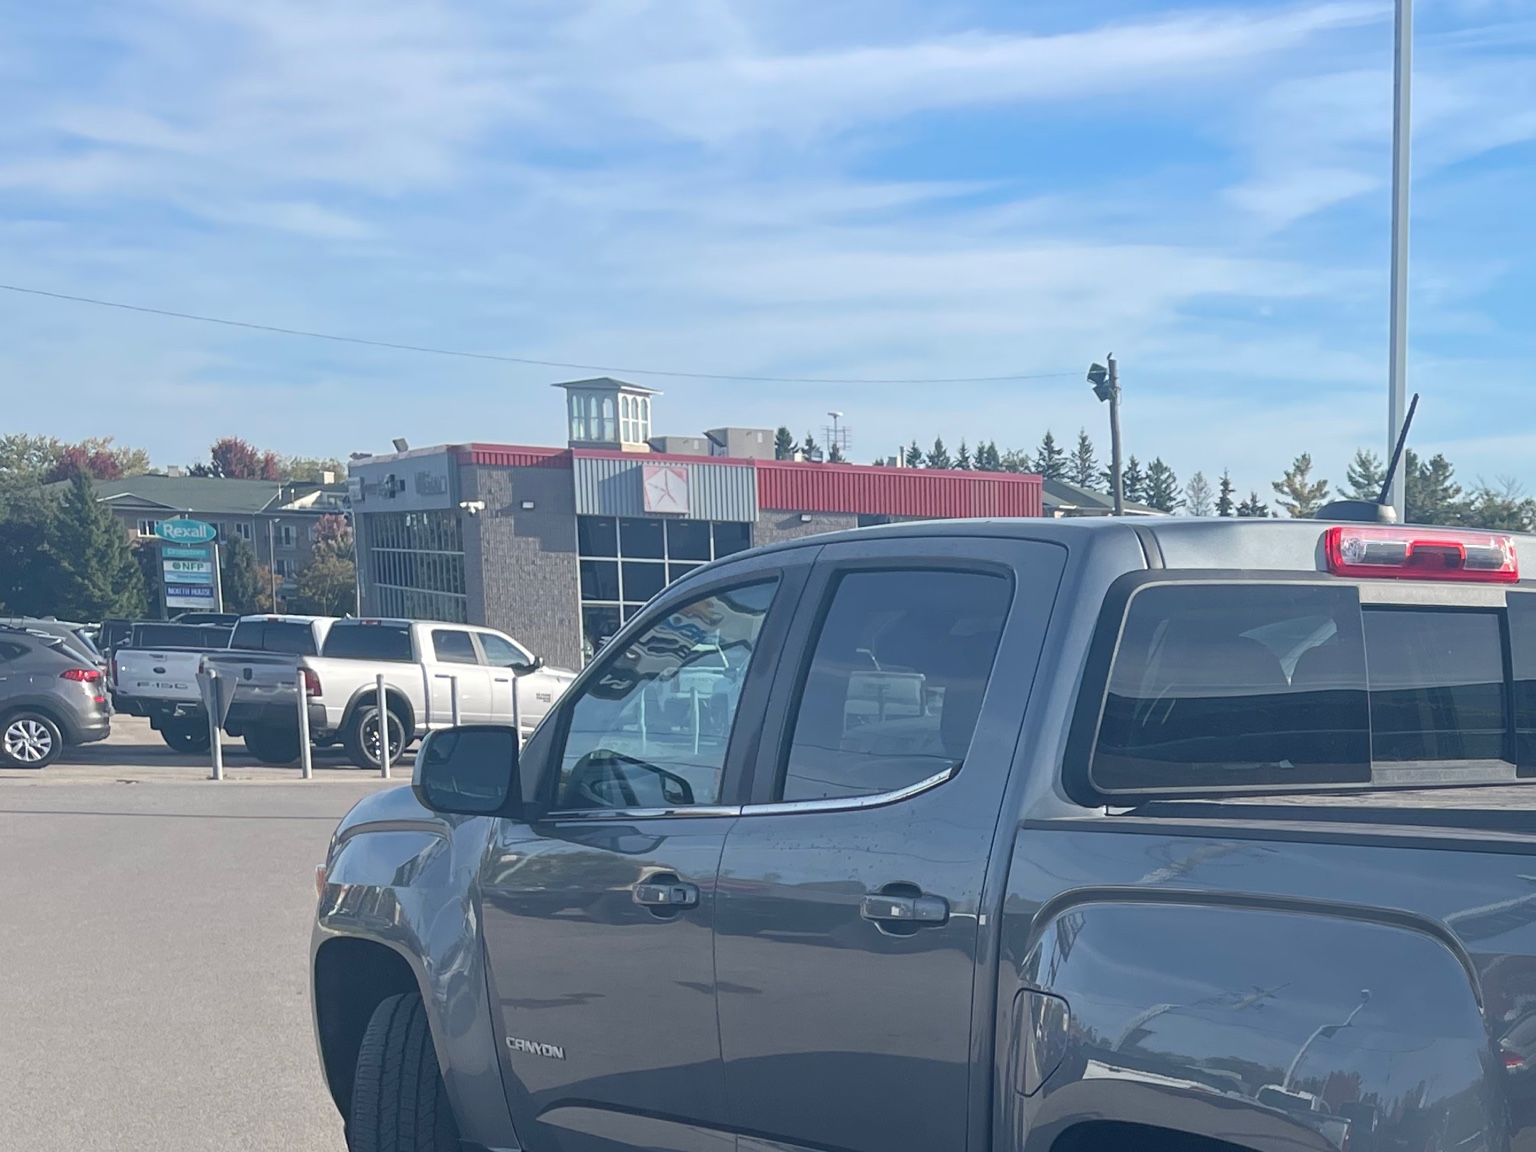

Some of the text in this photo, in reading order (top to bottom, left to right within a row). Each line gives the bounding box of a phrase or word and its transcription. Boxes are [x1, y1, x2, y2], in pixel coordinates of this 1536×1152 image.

[163, 524, 207, 538] Rexall
[182, 562, 204, 571] NFP
[505, 1036, 564, 1059] CANYON
